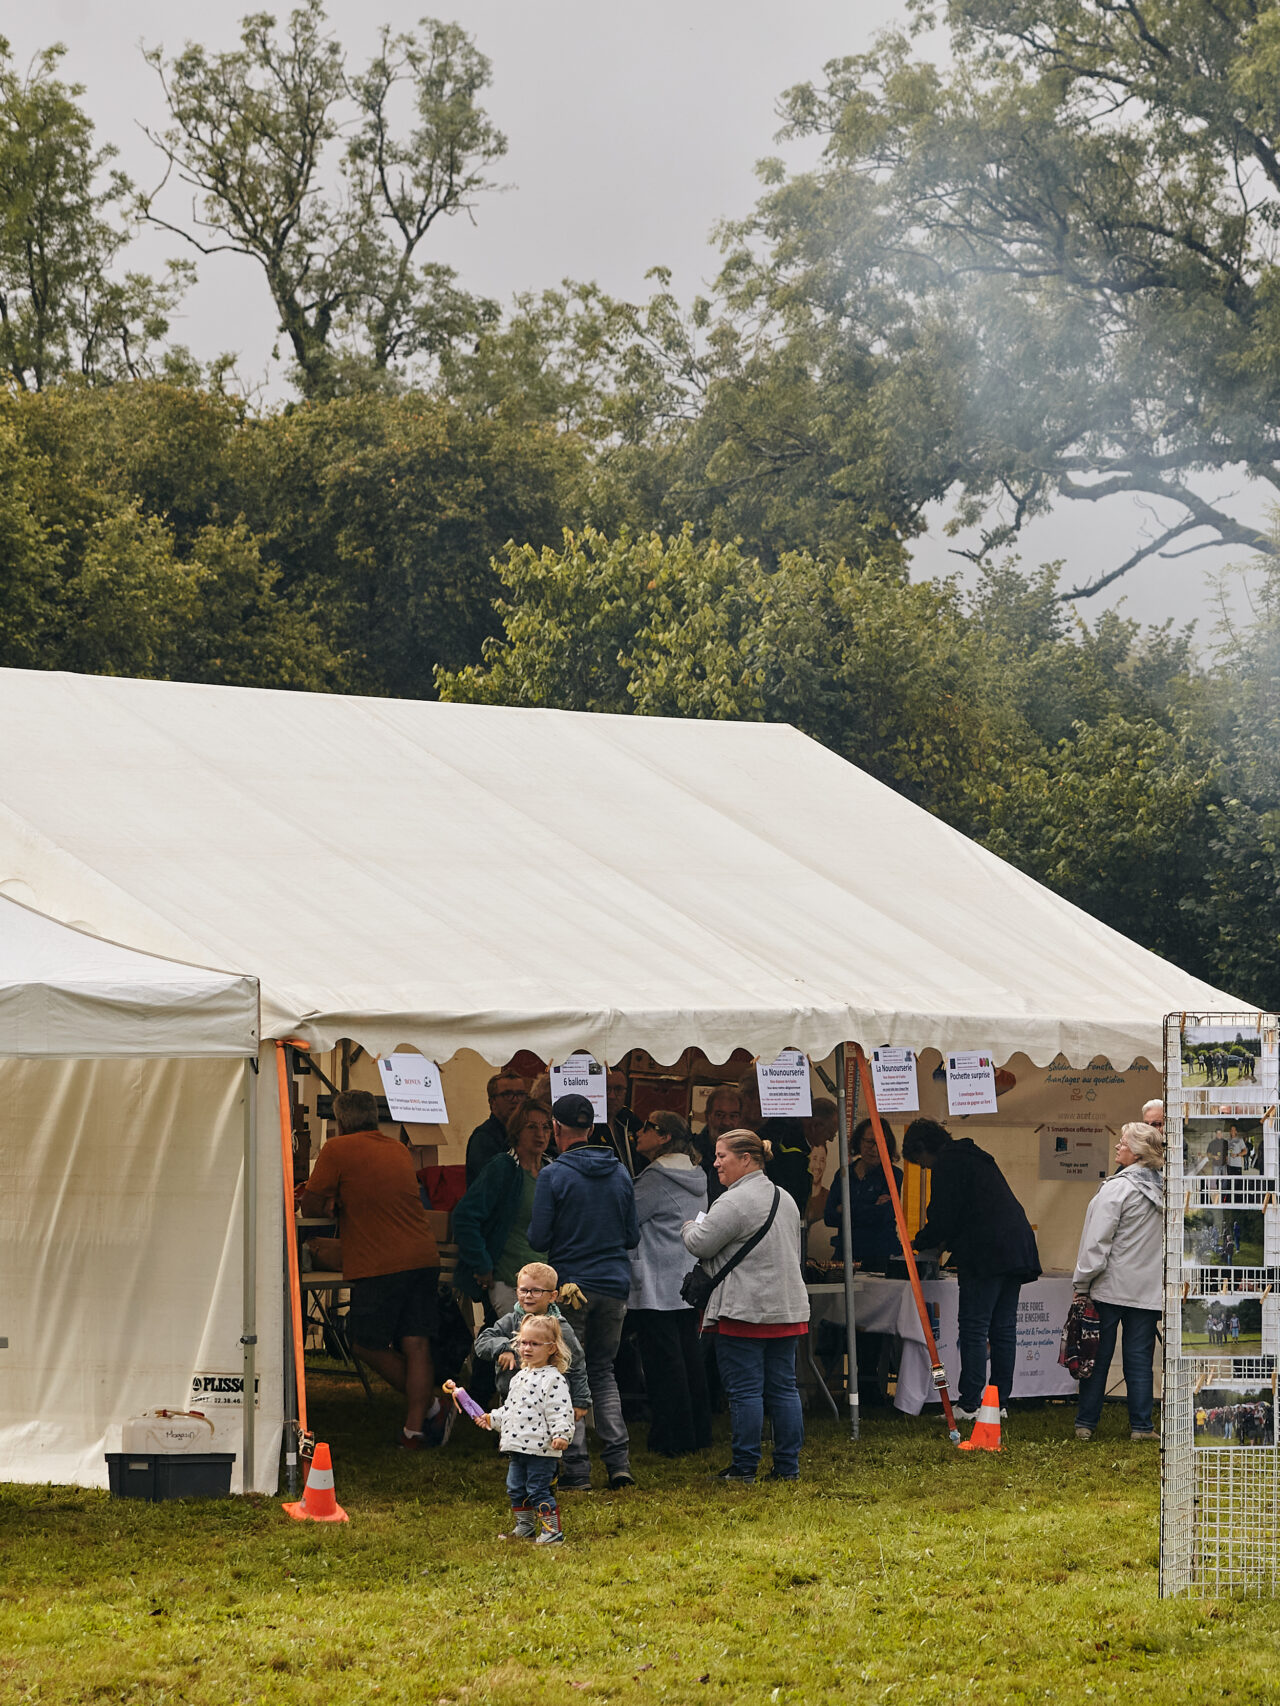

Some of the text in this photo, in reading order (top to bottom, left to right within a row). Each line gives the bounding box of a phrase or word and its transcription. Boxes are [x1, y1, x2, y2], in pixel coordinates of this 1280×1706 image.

[762, 1067, 805, 1077] La Nounourserie
[876, 1063, 912, 1073] La Nounourserie
[949, 1070, 990, 1081] Pochette surprise
[1045, 1075, 1080, 1085] Avantages
[1094, 1075, 1125, 1085] quotidien
[563, 1077, 589, 1086] 6 ballons
[1029, 1301, 1044, 1311] FORCE
[1025, 1312, 1050, 1322] ENSEMBLE
[203, 1377, 259, 1394] PLISS
[165, 1429, 197, 1441] Magasin
